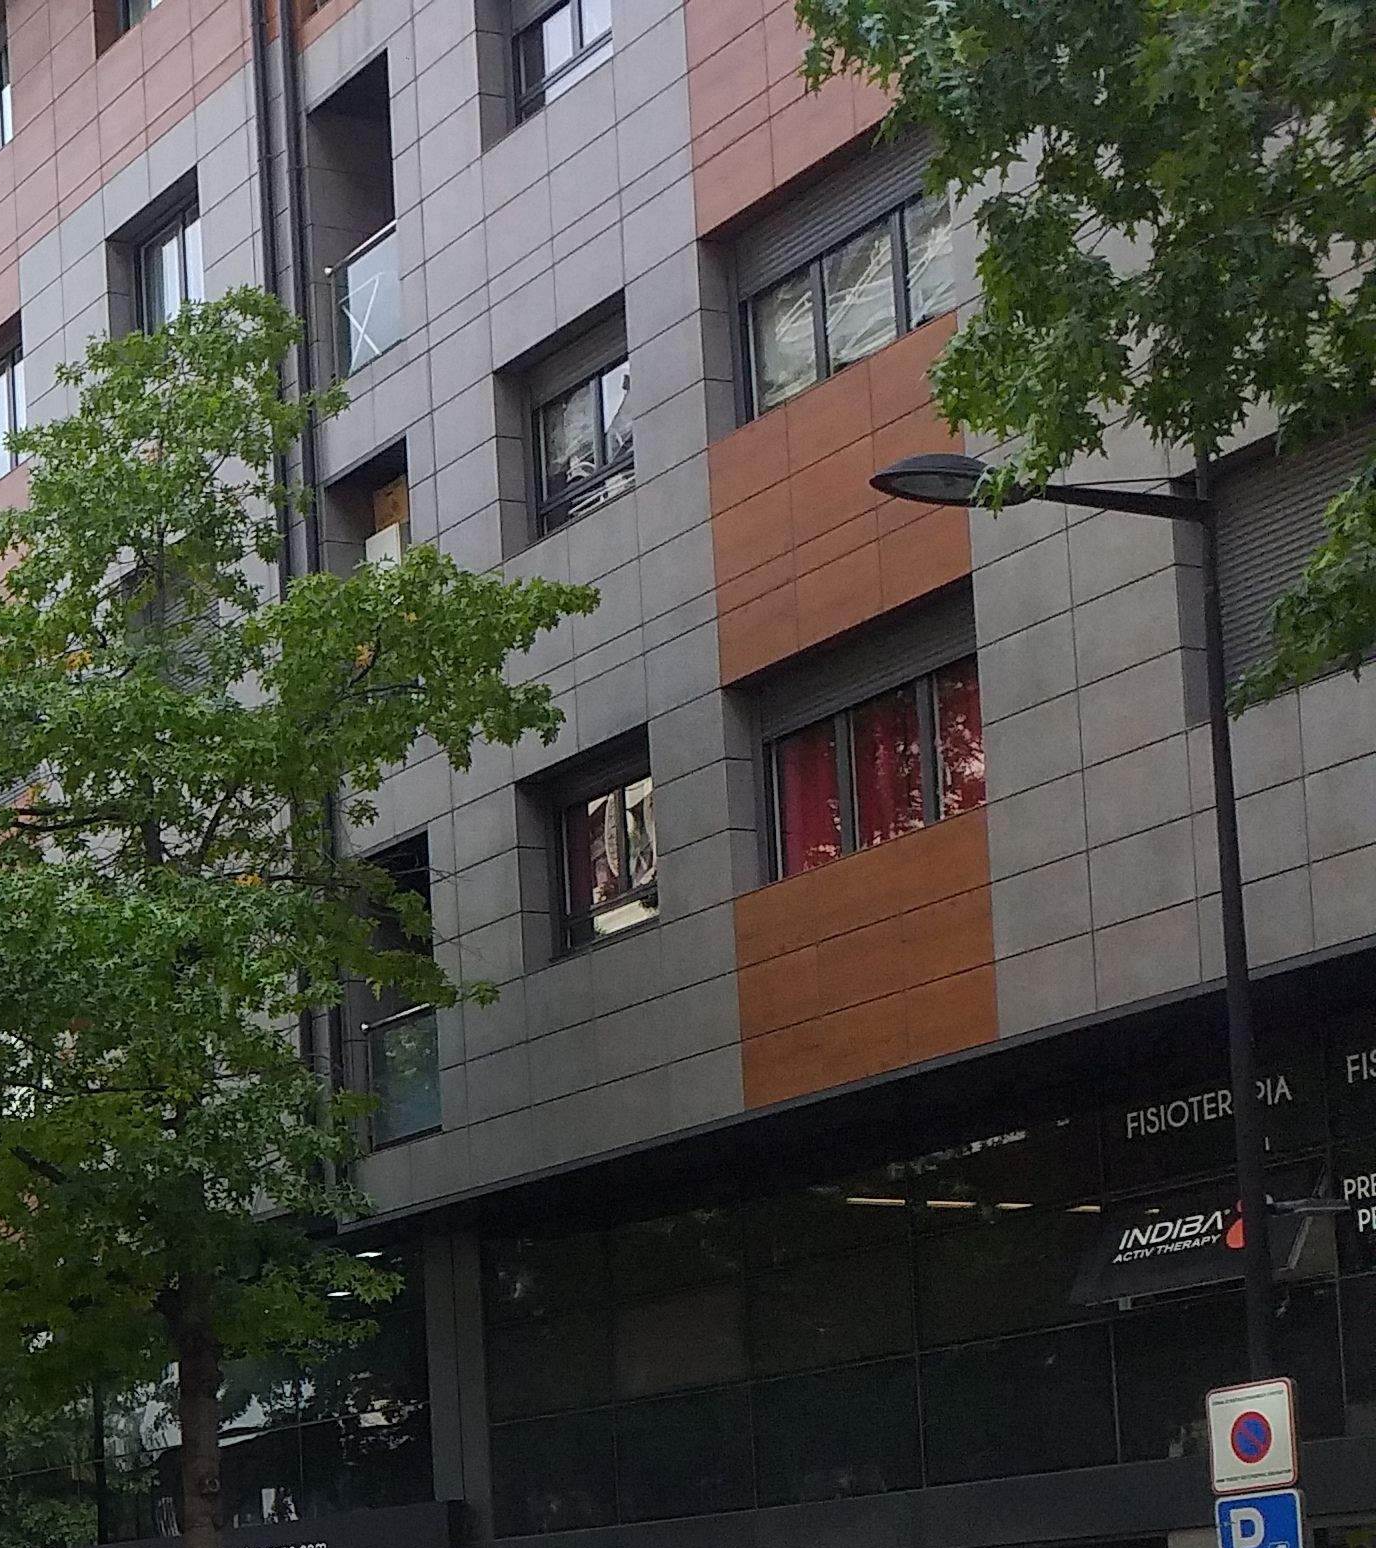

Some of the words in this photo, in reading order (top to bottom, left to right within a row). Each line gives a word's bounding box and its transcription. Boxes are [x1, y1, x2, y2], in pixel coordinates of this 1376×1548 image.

[1126, 1075, 1293, 1139] FISIOTERPIA
[1112, 1247, 1153, 1264] ACTIV
[1155, 1233, 1223, 1256] THERAPY
[1118, 1210, 1224, 1250] INDIBA
